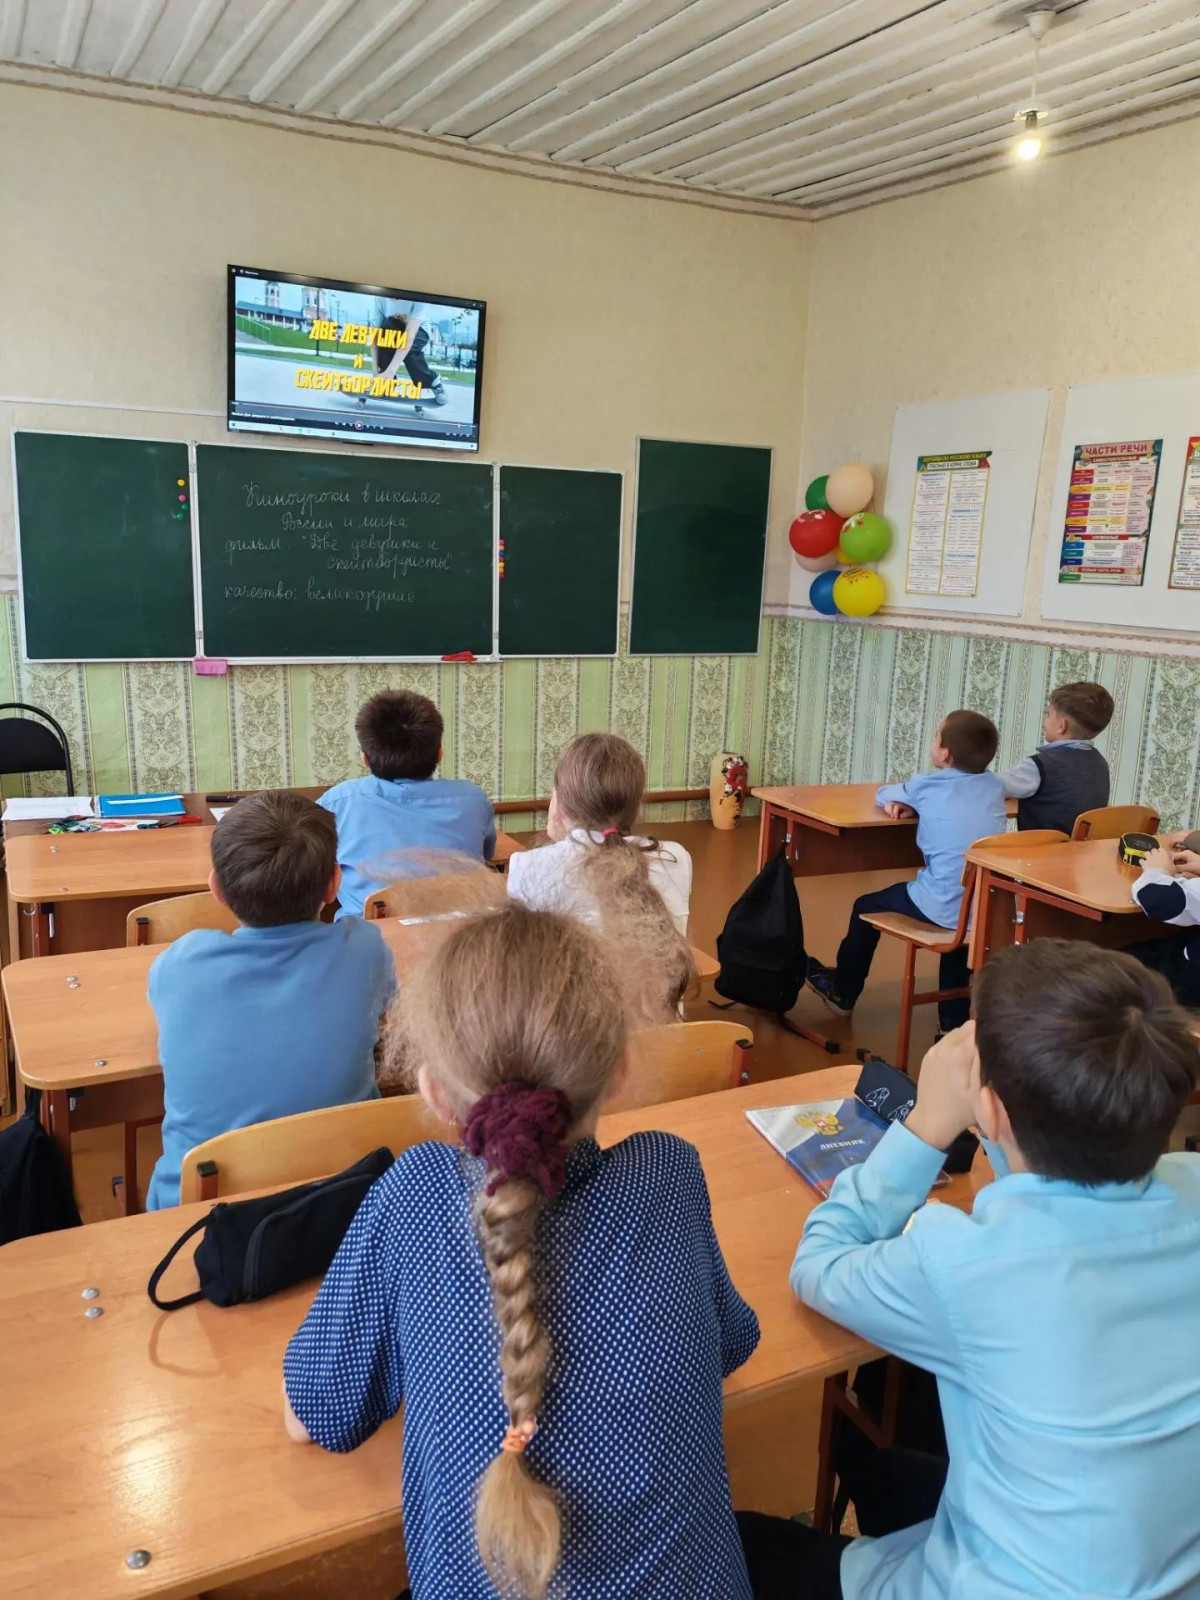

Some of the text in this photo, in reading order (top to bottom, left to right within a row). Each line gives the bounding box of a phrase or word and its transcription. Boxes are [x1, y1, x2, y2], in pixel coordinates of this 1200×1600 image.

[309, 319, 408, 349] ДВЕ ДЕВУШКИ
[353, 353, 365, 369] И
[1085, 443, 1147, 455] ЧАСТИ РЕЧИ
[242, 481, 441, 516] Киноуроки в школах
[281, 511, 408, 540] России и мира
[351, 533, 421, 559] девушки
[819, 1139, 866, 1151] ДНЕВНИК
